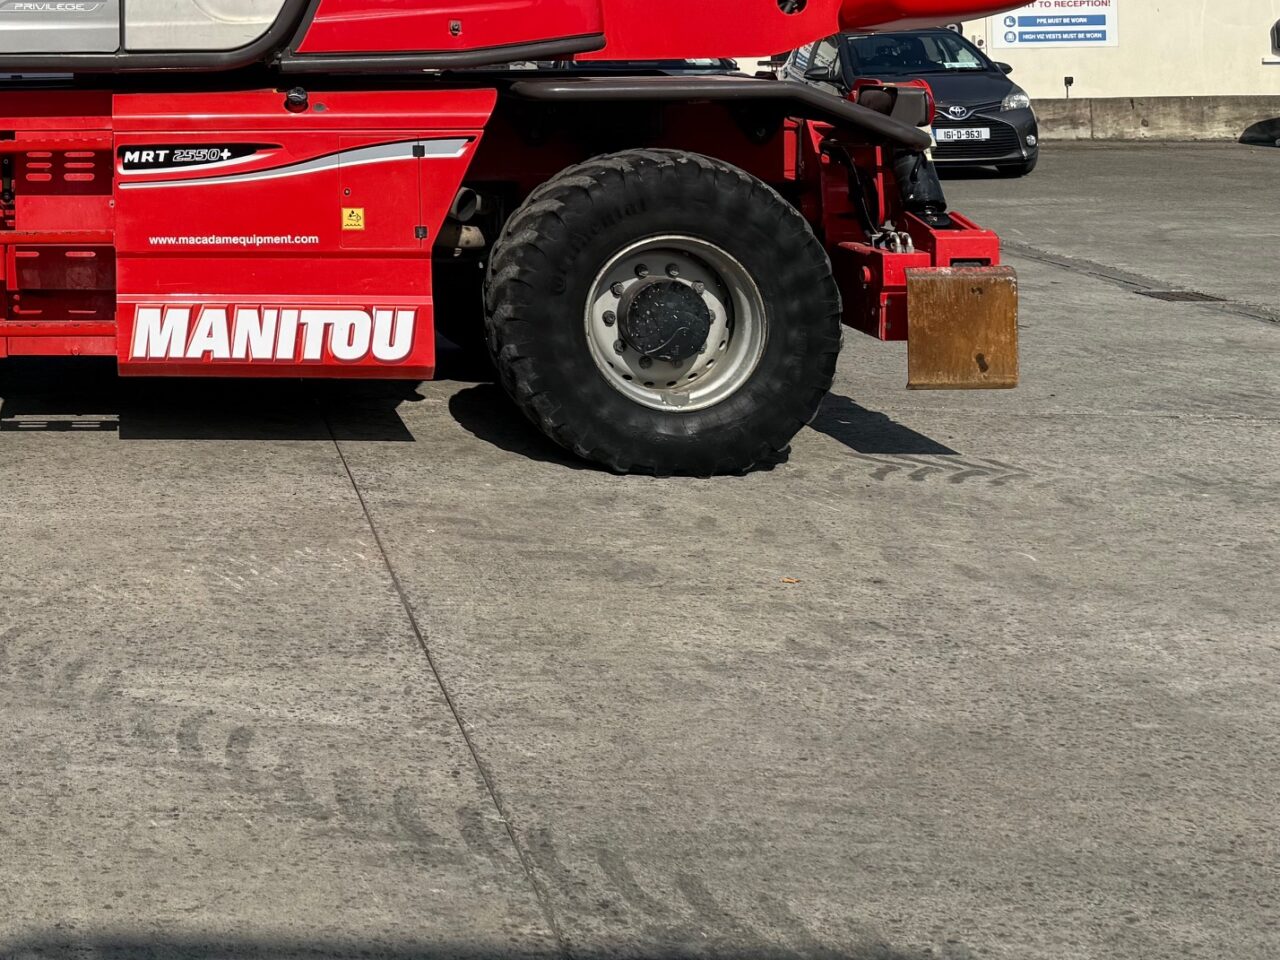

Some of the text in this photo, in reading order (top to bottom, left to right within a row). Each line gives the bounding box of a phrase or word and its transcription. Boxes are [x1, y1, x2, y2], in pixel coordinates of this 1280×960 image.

[14, 3, 85, 11] PRIVILEGE
[1054, 0, 1111, 8] RECEPTION!
[943, 130, 982, 139] 161-D-9631
[124, 148, 231, 163] MRT 2550+
[149, 234, 319, 246] www.macadamequipment.com
[130, 305, 417, 362] MANITOU
